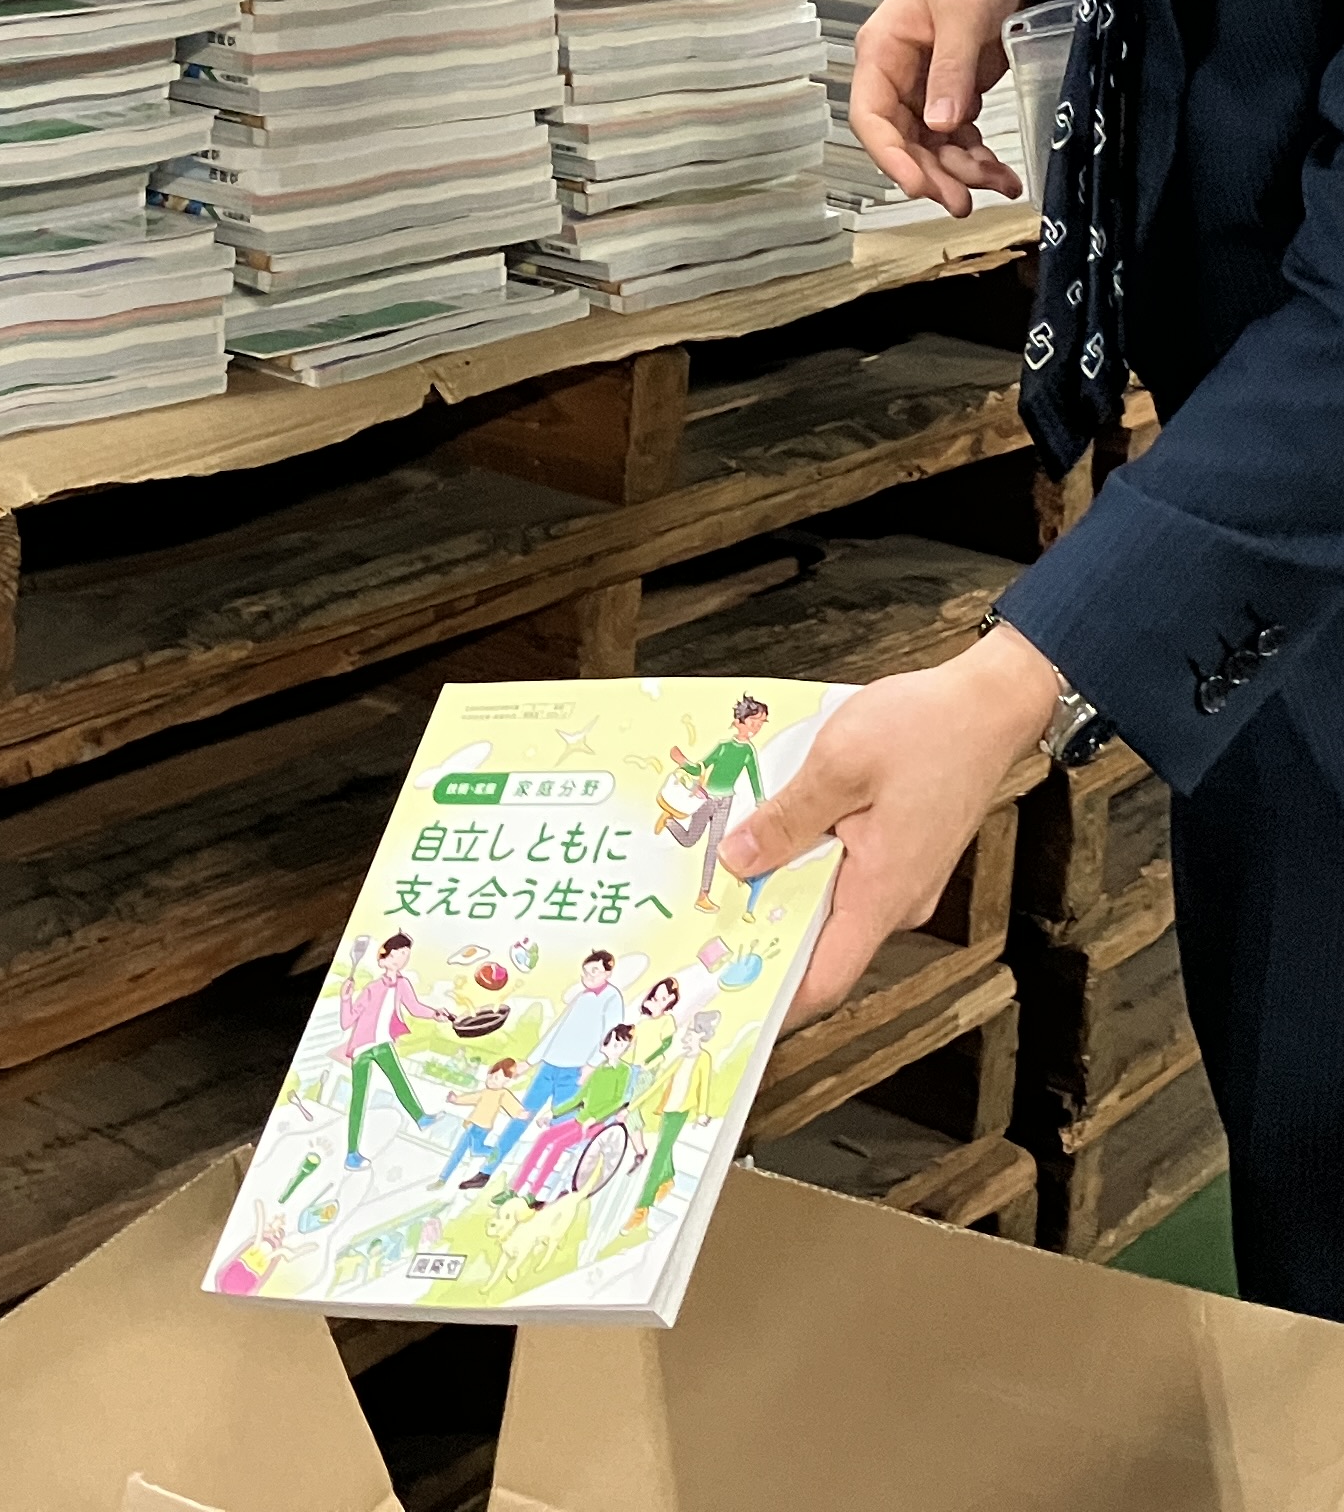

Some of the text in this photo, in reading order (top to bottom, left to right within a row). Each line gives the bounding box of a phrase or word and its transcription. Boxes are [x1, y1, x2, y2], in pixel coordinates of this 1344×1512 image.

[512, 779, 600, 798] 家庭分野
[383, 873, 674, 925] 支え合う生活へ
